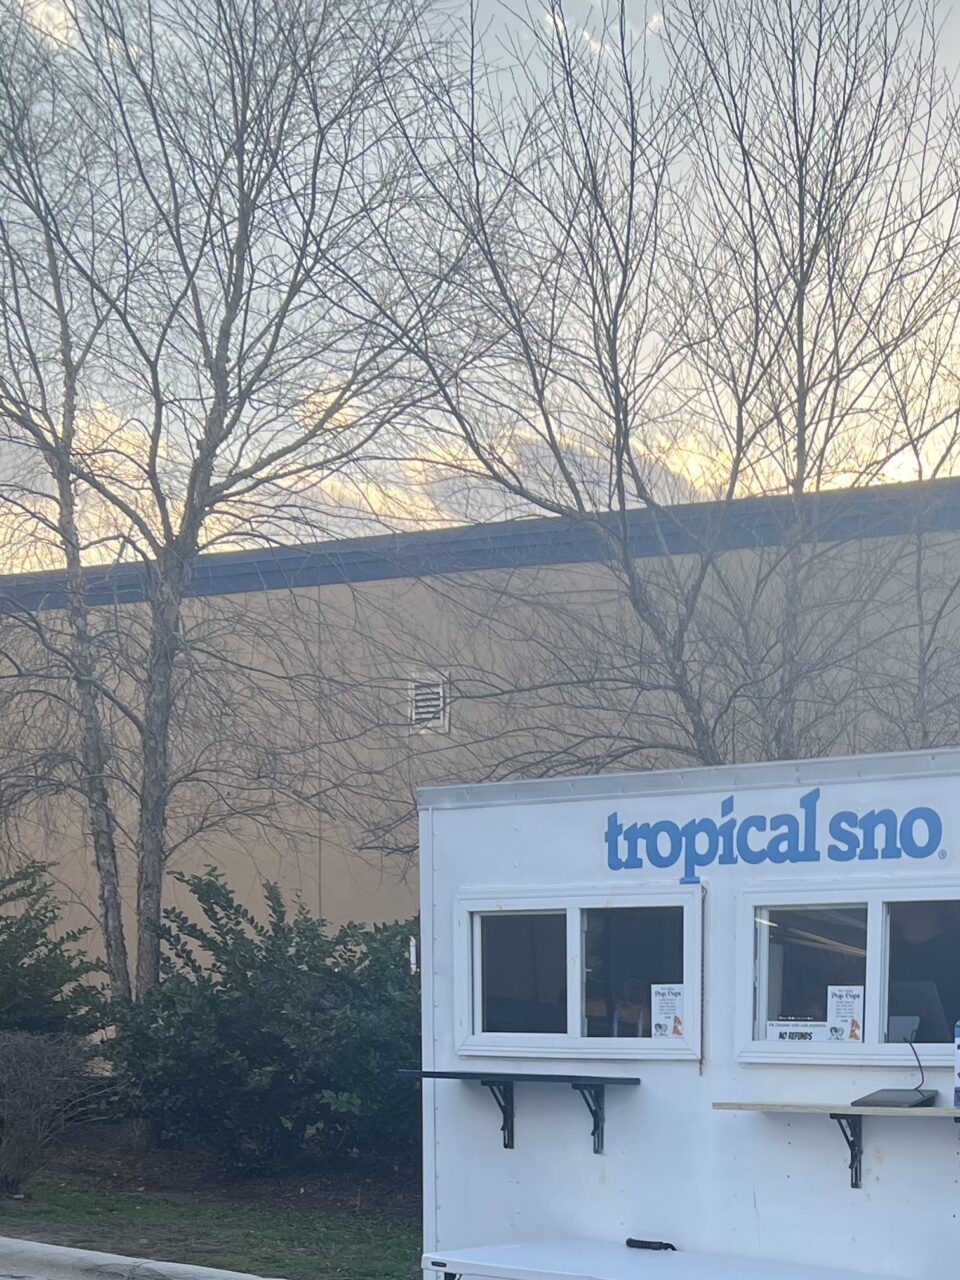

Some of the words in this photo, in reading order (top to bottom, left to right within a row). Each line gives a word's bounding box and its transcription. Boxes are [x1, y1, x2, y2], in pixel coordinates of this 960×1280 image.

[604, 788, 820, 884] tropical
[828, 806, 942, 860] sno
[779, 1032, 787, 1040] NO
[788, 1032, 813, 1040] REFUNDS
